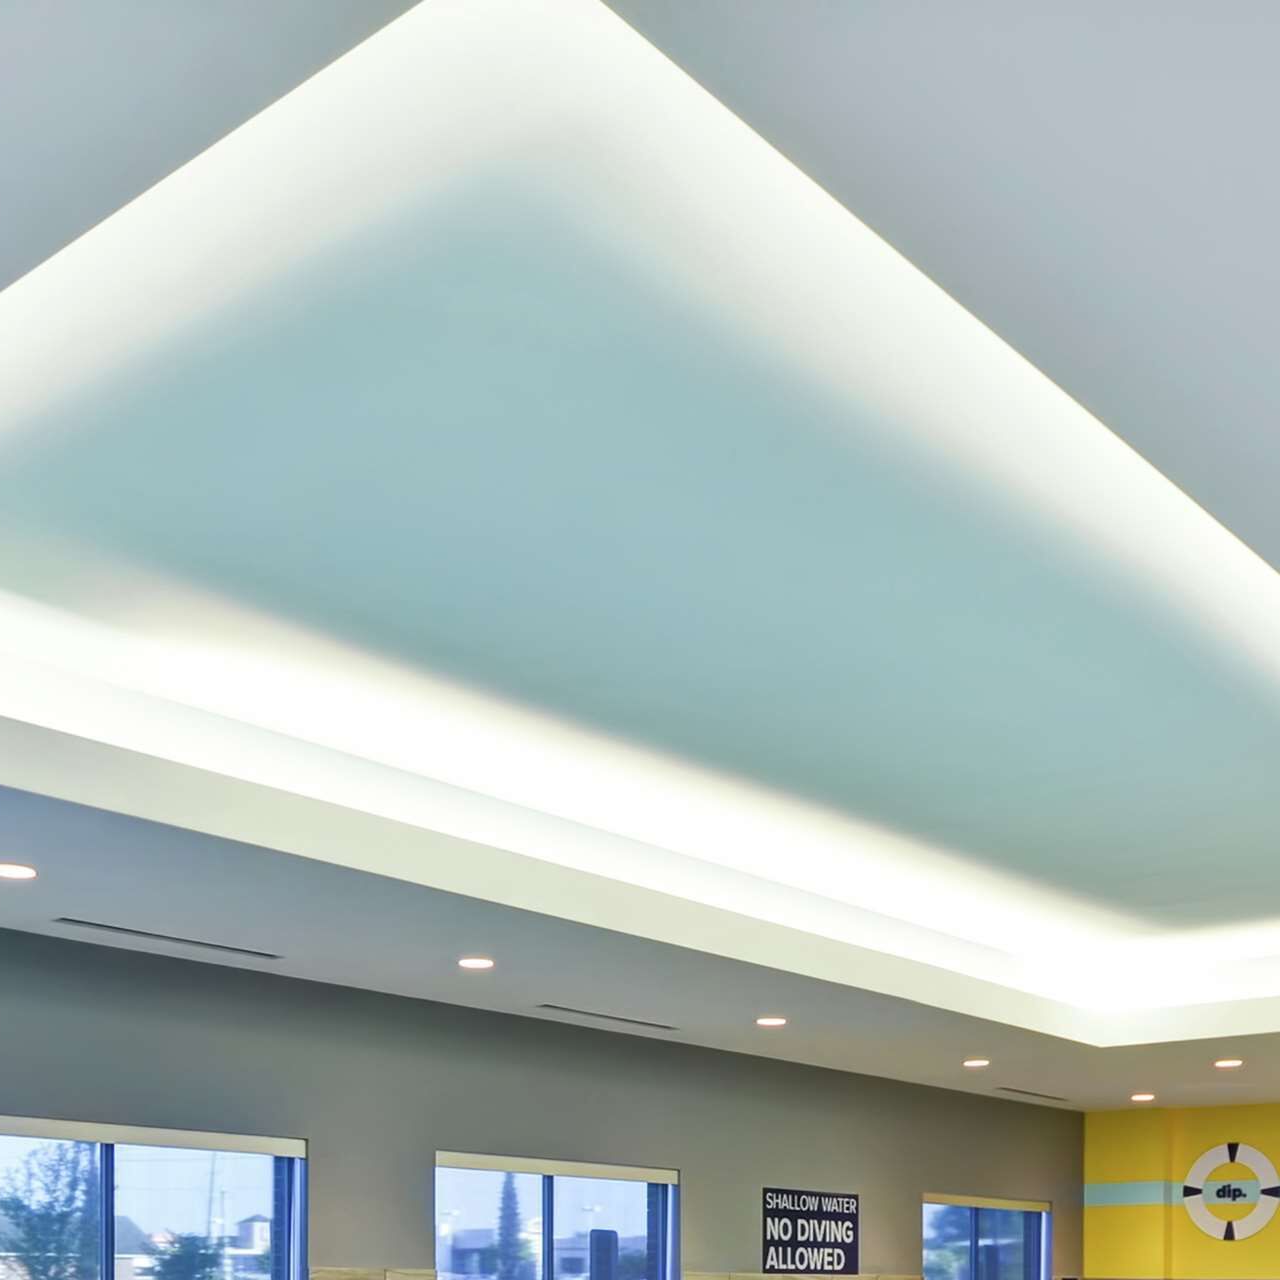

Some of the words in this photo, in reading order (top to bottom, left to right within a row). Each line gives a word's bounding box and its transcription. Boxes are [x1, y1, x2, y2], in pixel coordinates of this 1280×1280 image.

[766, 1193, 819, 1211] SHALLOW
[821, 1197, 857, 1214] WATER
[1216, 1184, 1247, 1201] dip.
[766, 1217, 792, 1241] NO
[797, 1219, 853, 1243] DIVING
[765, 1246, 846, 1270] ALLOWED
